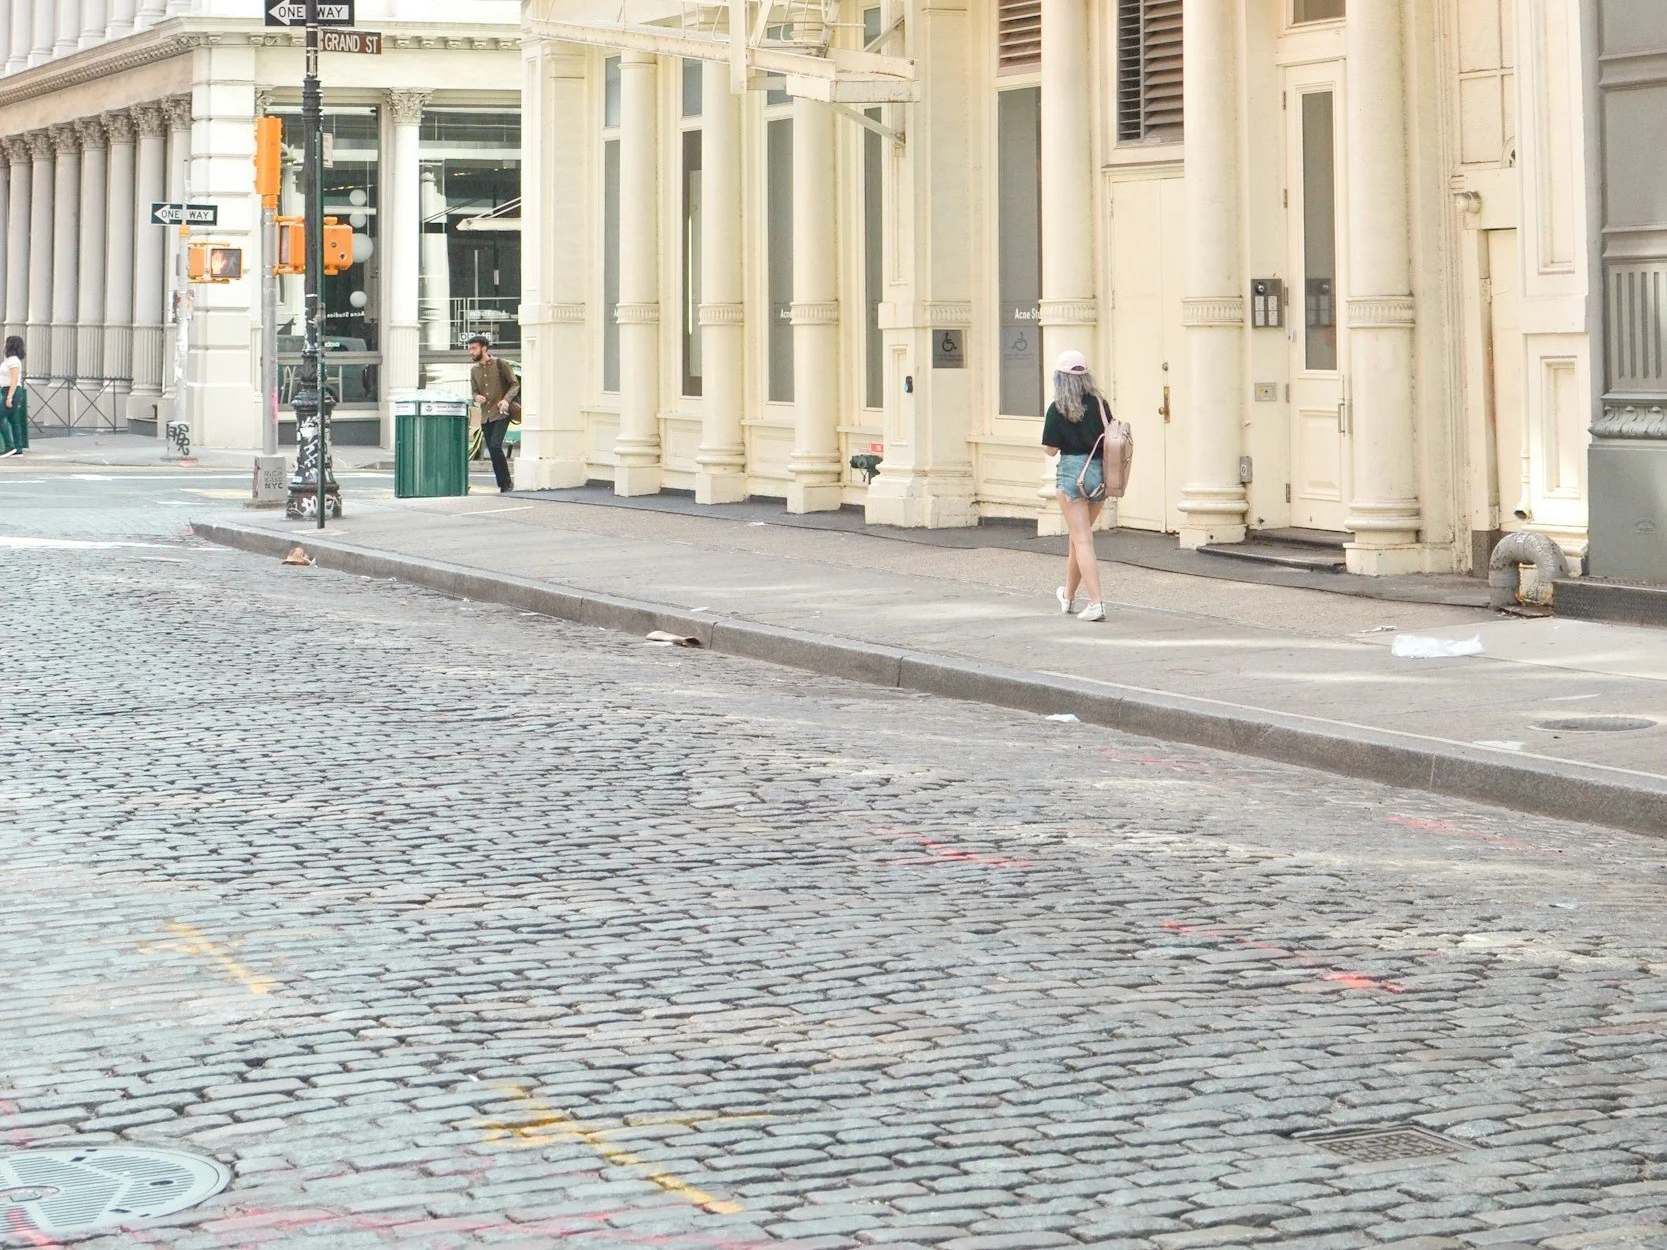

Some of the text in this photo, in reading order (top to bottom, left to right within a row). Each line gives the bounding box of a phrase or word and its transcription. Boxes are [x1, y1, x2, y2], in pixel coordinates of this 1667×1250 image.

[278, 6, 343, 18] ONE WAY
[324, 33, 378, 53] GRAND ST
[161, 209, 209, 220] ONE WAY
[1014, 308, 1031, 320] Acne
